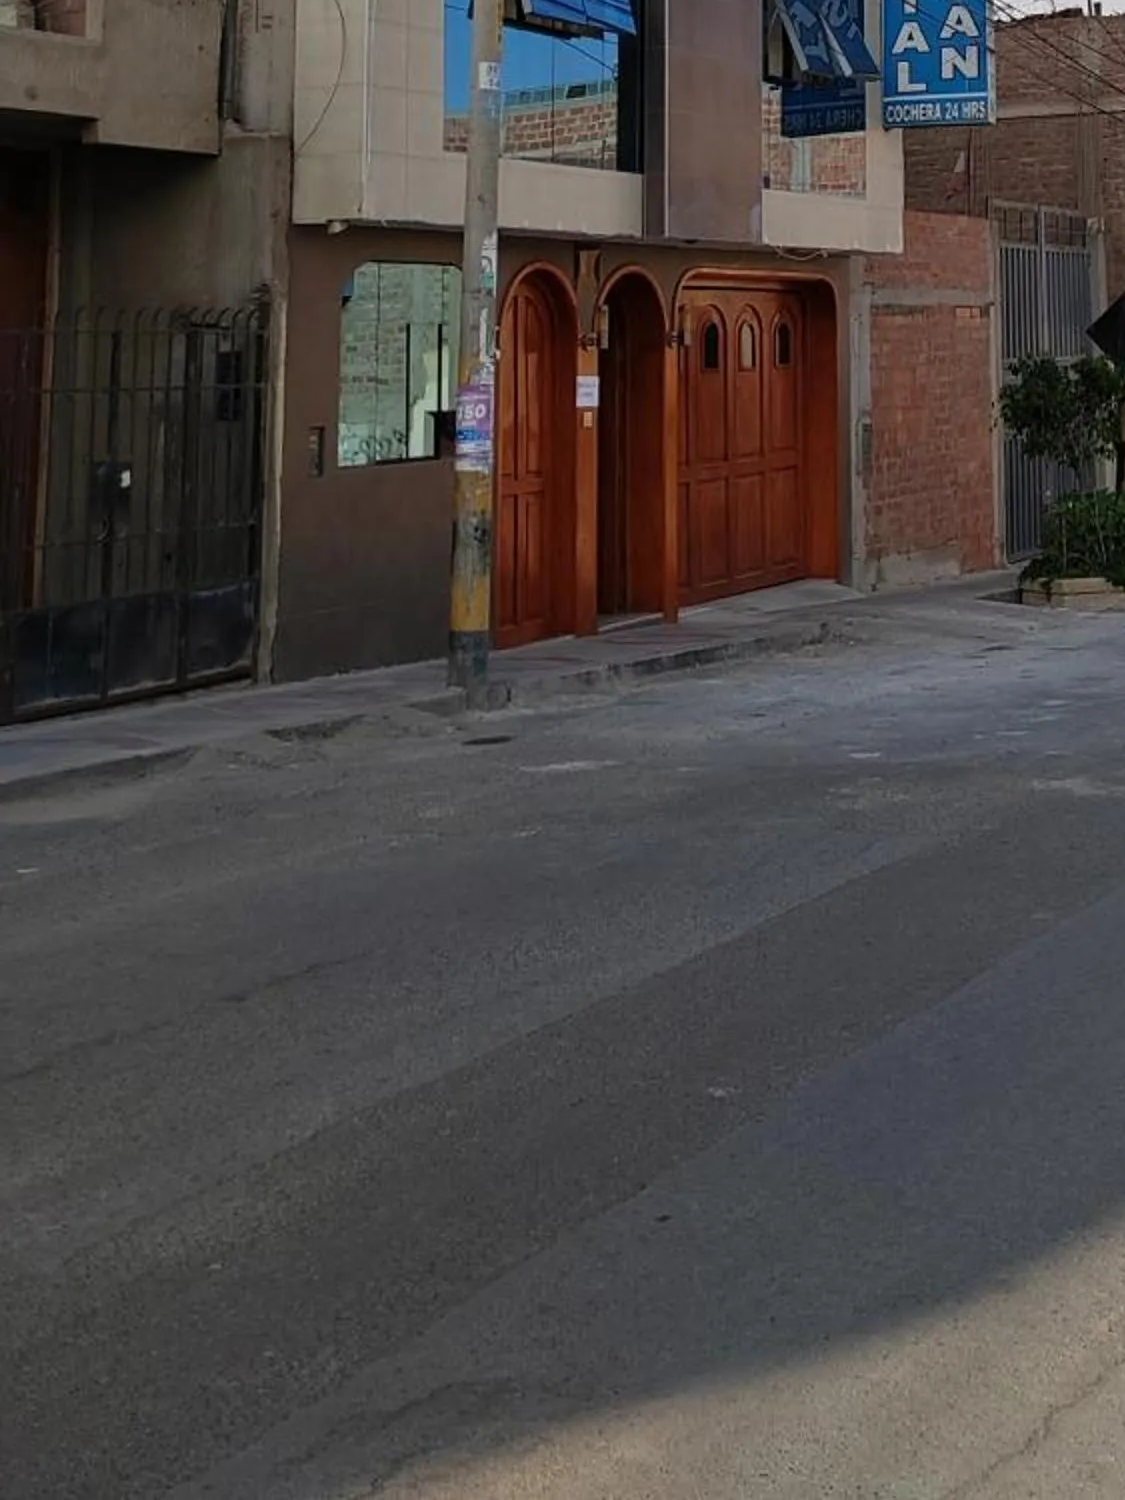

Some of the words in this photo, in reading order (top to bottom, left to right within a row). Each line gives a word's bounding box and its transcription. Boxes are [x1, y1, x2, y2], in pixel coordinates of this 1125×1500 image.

[886, 103, 942, 123] COCHERA
[945, 102, 959, 120] 24
[962, 101, 985, 119] HRS
